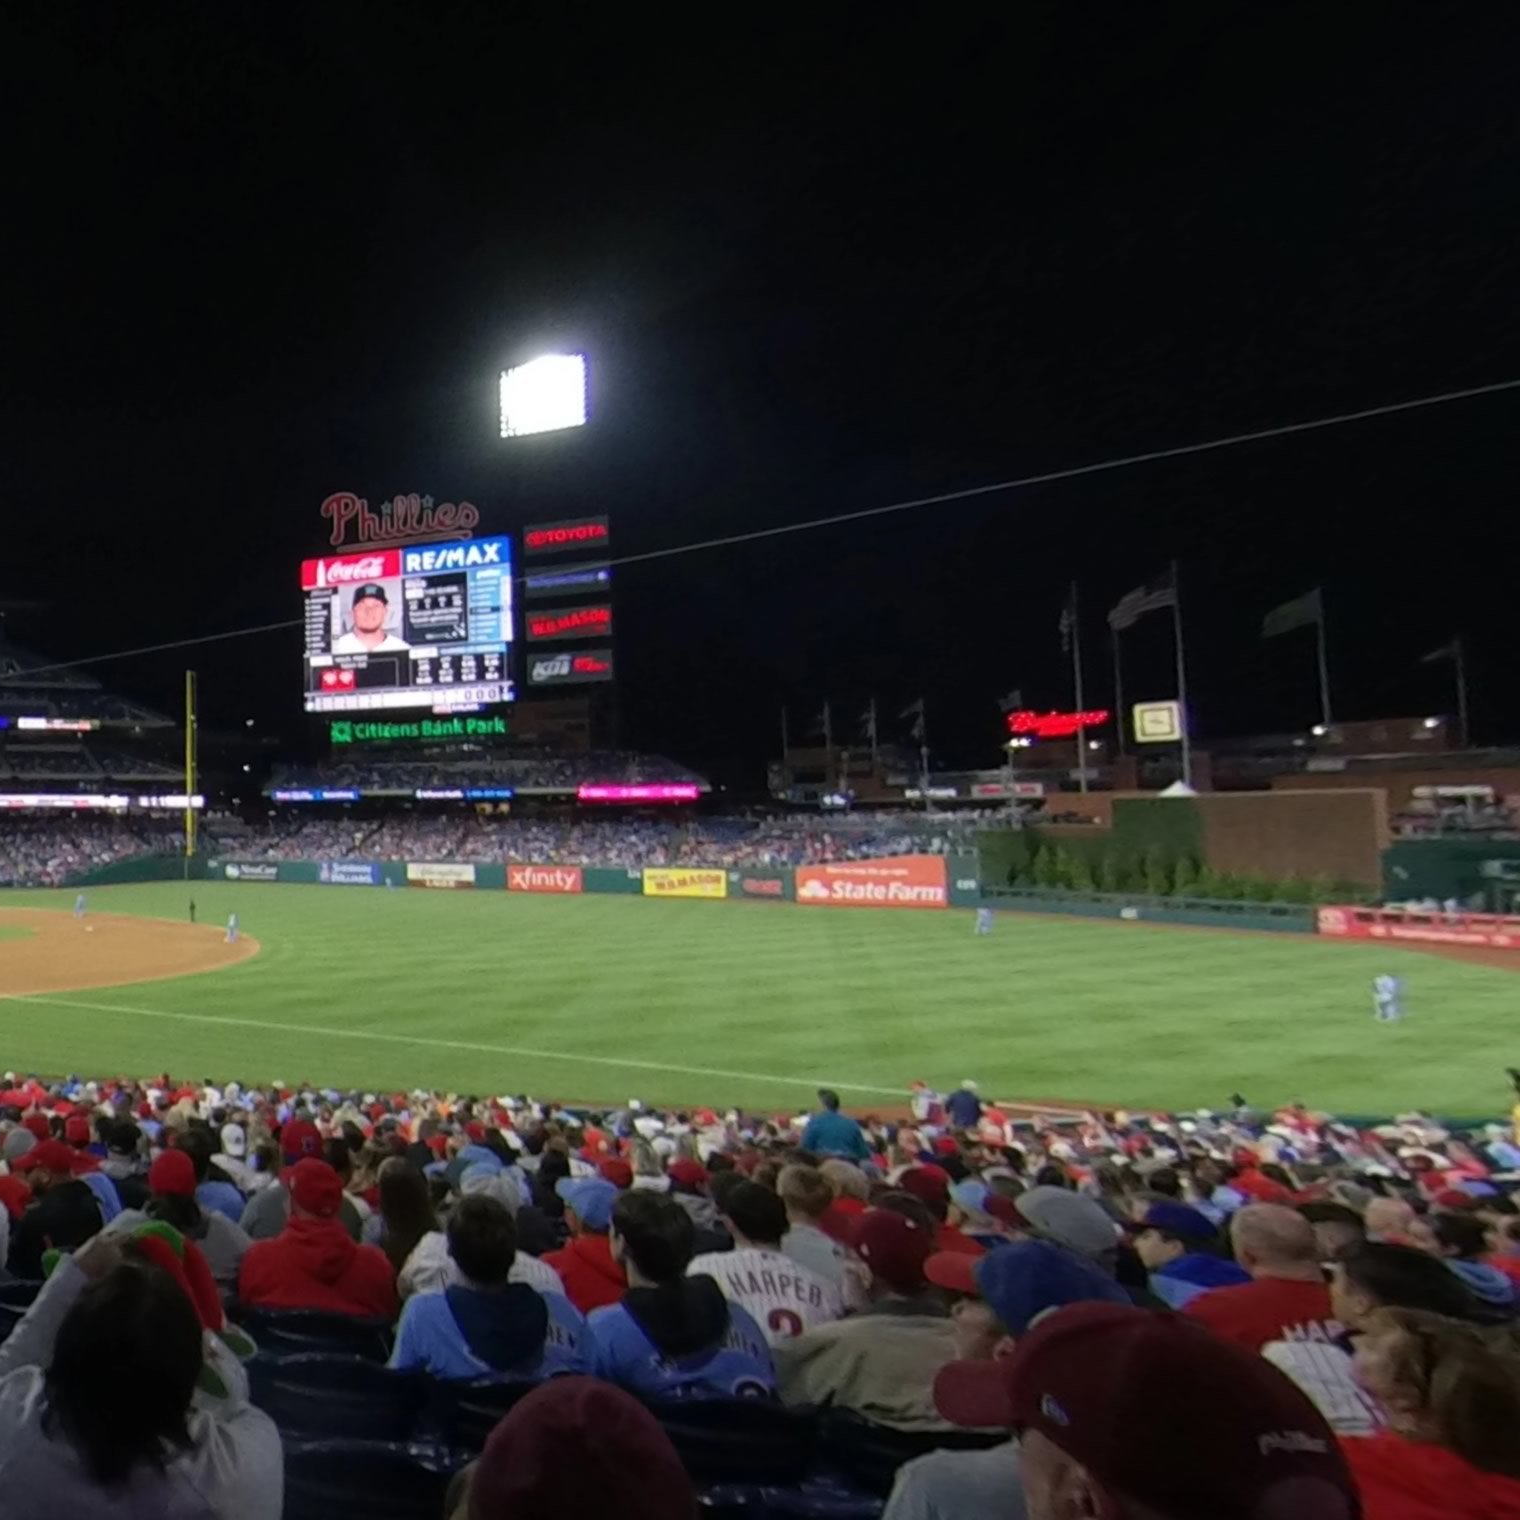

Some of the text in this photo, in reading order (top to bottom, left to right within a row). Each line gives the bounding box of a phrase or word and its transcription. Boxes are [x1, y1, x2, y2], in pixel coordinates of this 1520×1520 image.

[321, 491, 479, 546] Phillies
[545, 524, 607, 544] TOYOTA
[406, 543, 502, 572] RE/MAX
[355, 717, 505, 739] Citizens Bank Park
[512, 866, 576, 890] xfinity
[831, 880, 885, 900] State
[887, 881, 945, 901] Farm
[727, 1270, 822, 1307] HARPER
